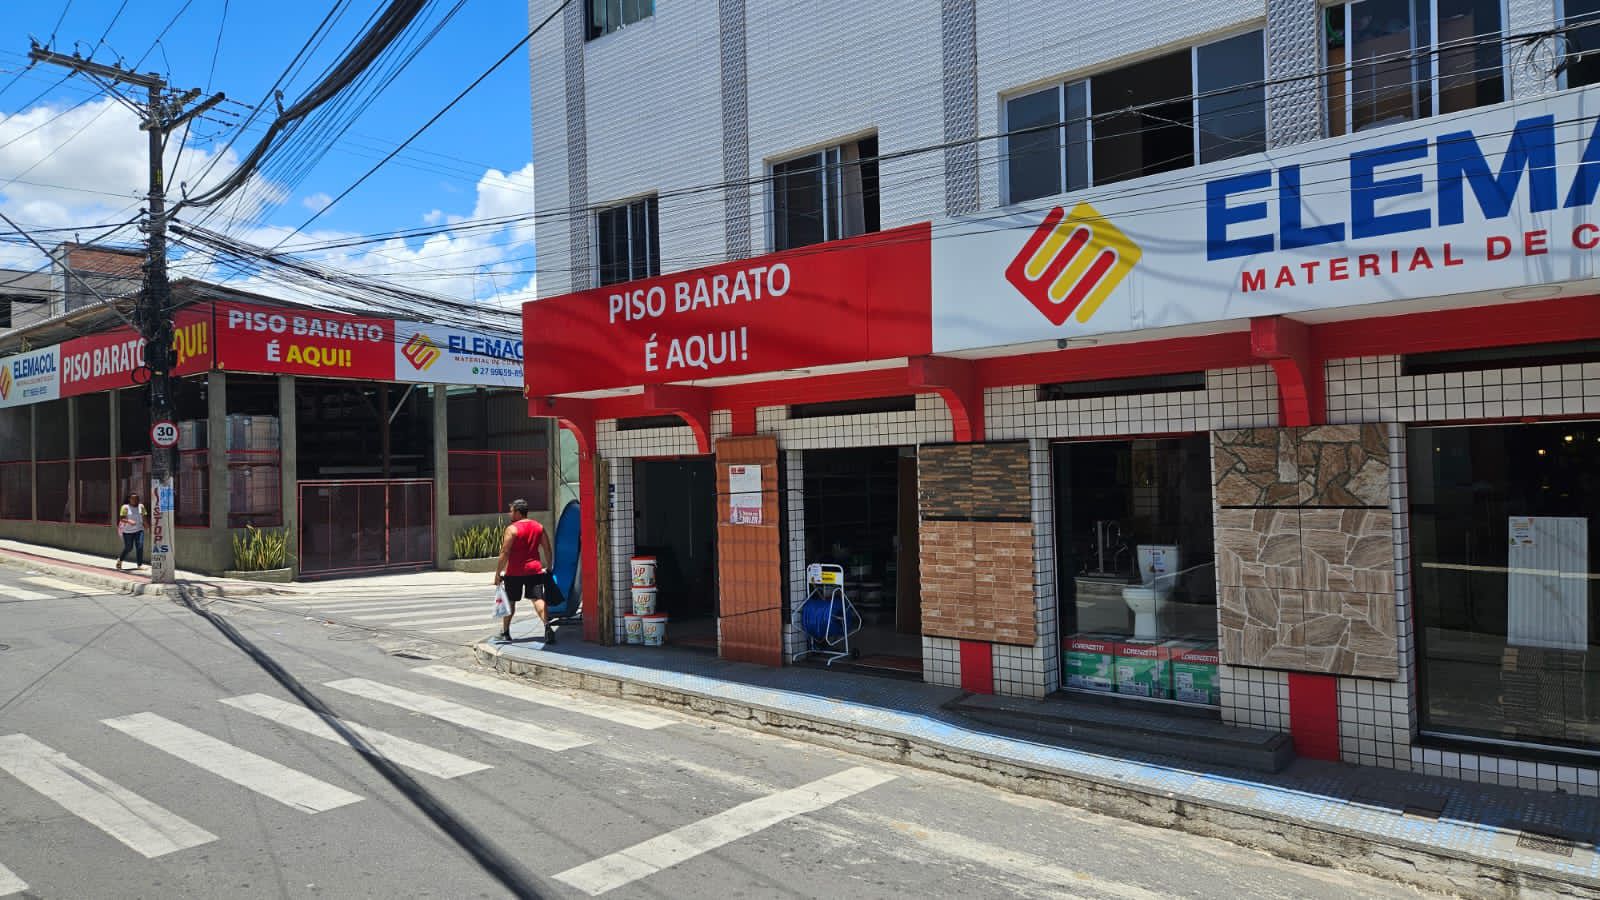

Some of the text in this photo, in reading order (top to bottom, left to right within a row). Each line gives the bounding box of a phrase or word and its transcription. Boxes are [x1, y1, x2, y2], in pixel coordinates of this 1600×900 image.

[1241, 242, 1464, 293] MATERIAL
[1486, 229, 1549, 261] DE
[609, 263, 791, 324] PISO BARATO
[228, 309, 384, 343] PISO BARATO
[63, 351, 91, 384] PISO
[172, 321, 208, 364] QUI!
[266, 339, 351, 367] É AQUI!
[645, 326, 748, 372] É AQUI!
[13, 351, 57, 380] ELEMACOL
[157, 426, 174, 436] 30
[1071, 640, 1105, 652] LORENZETTI
[1123, 647, 1158, 657] LORENZETTI
